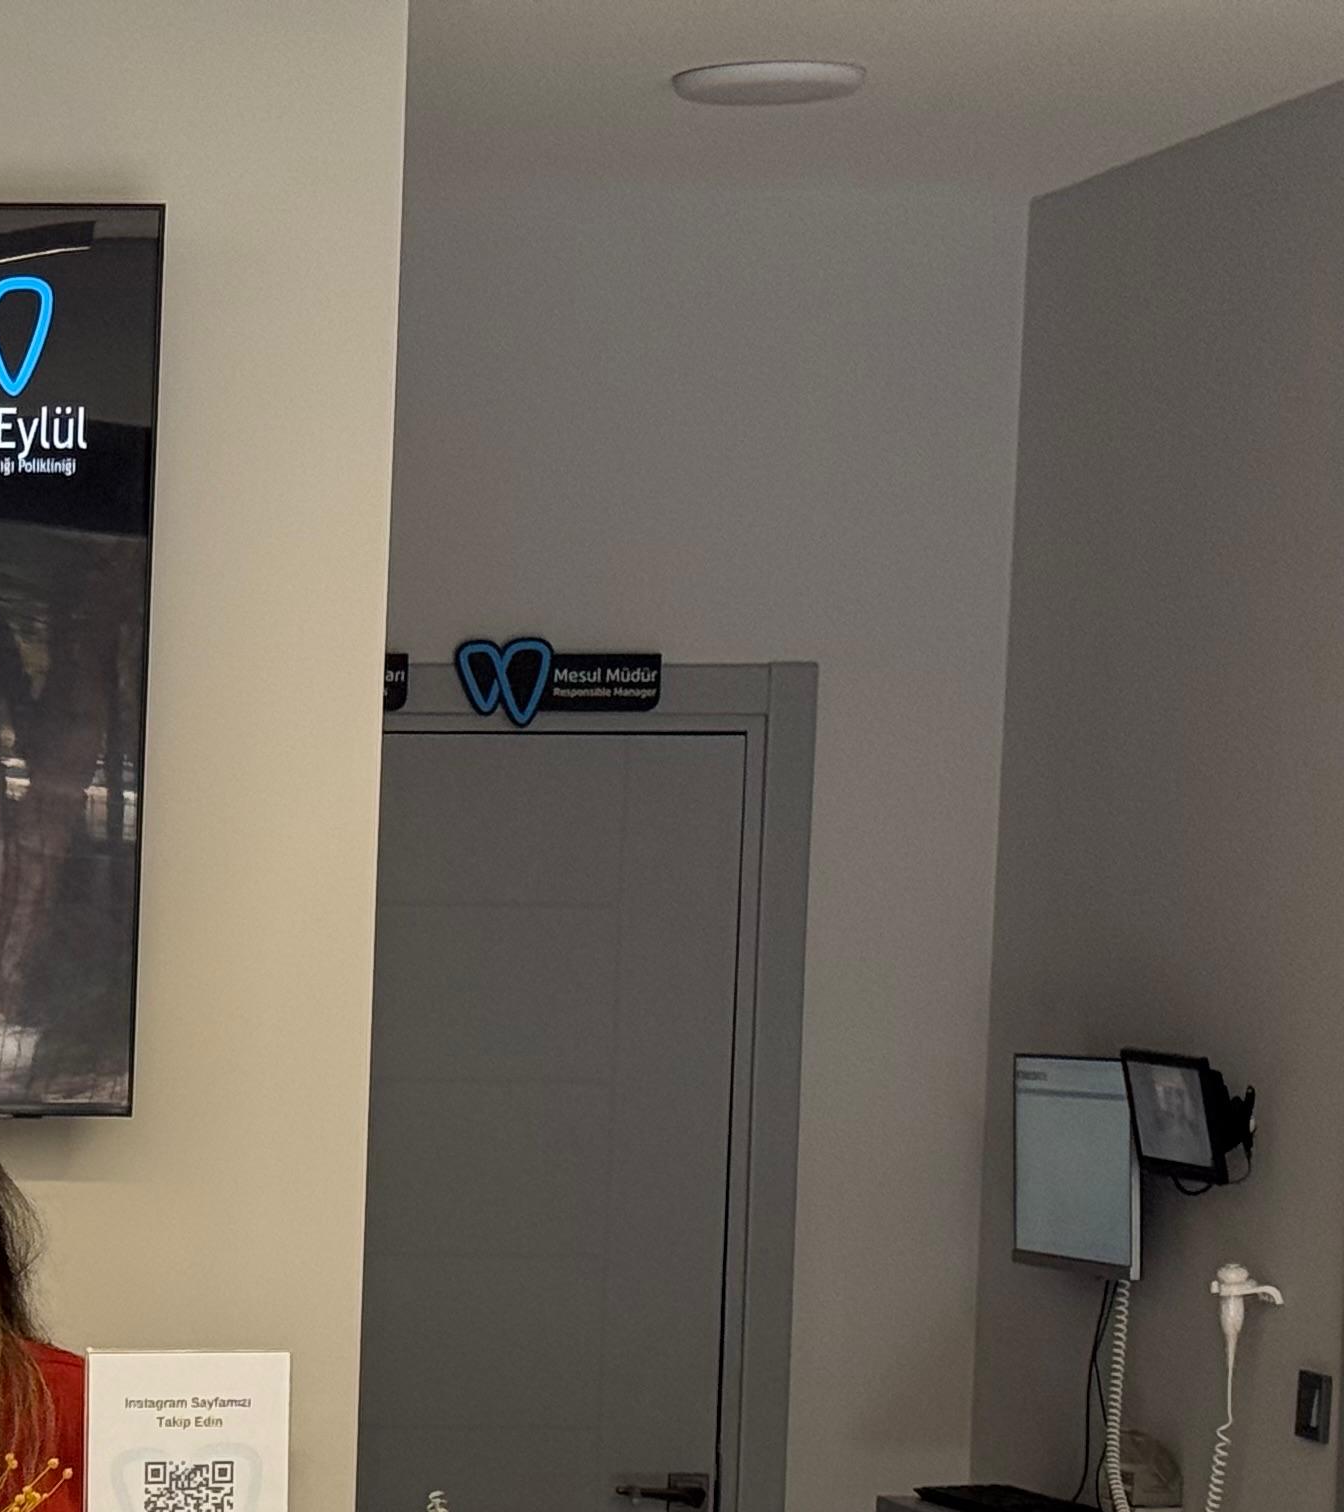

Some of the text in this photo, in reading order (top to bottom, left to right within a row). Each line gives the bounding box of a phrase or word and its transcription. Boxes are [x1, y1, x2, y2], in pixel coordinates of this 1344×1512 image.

[18, 458, 76, 476] Polikliniği
[553, 666, 658, 683] Mesul Müdür
[124, 1398, 188, 1411] Instagram
[156, 1416, 224, 1430] Takip Edin
